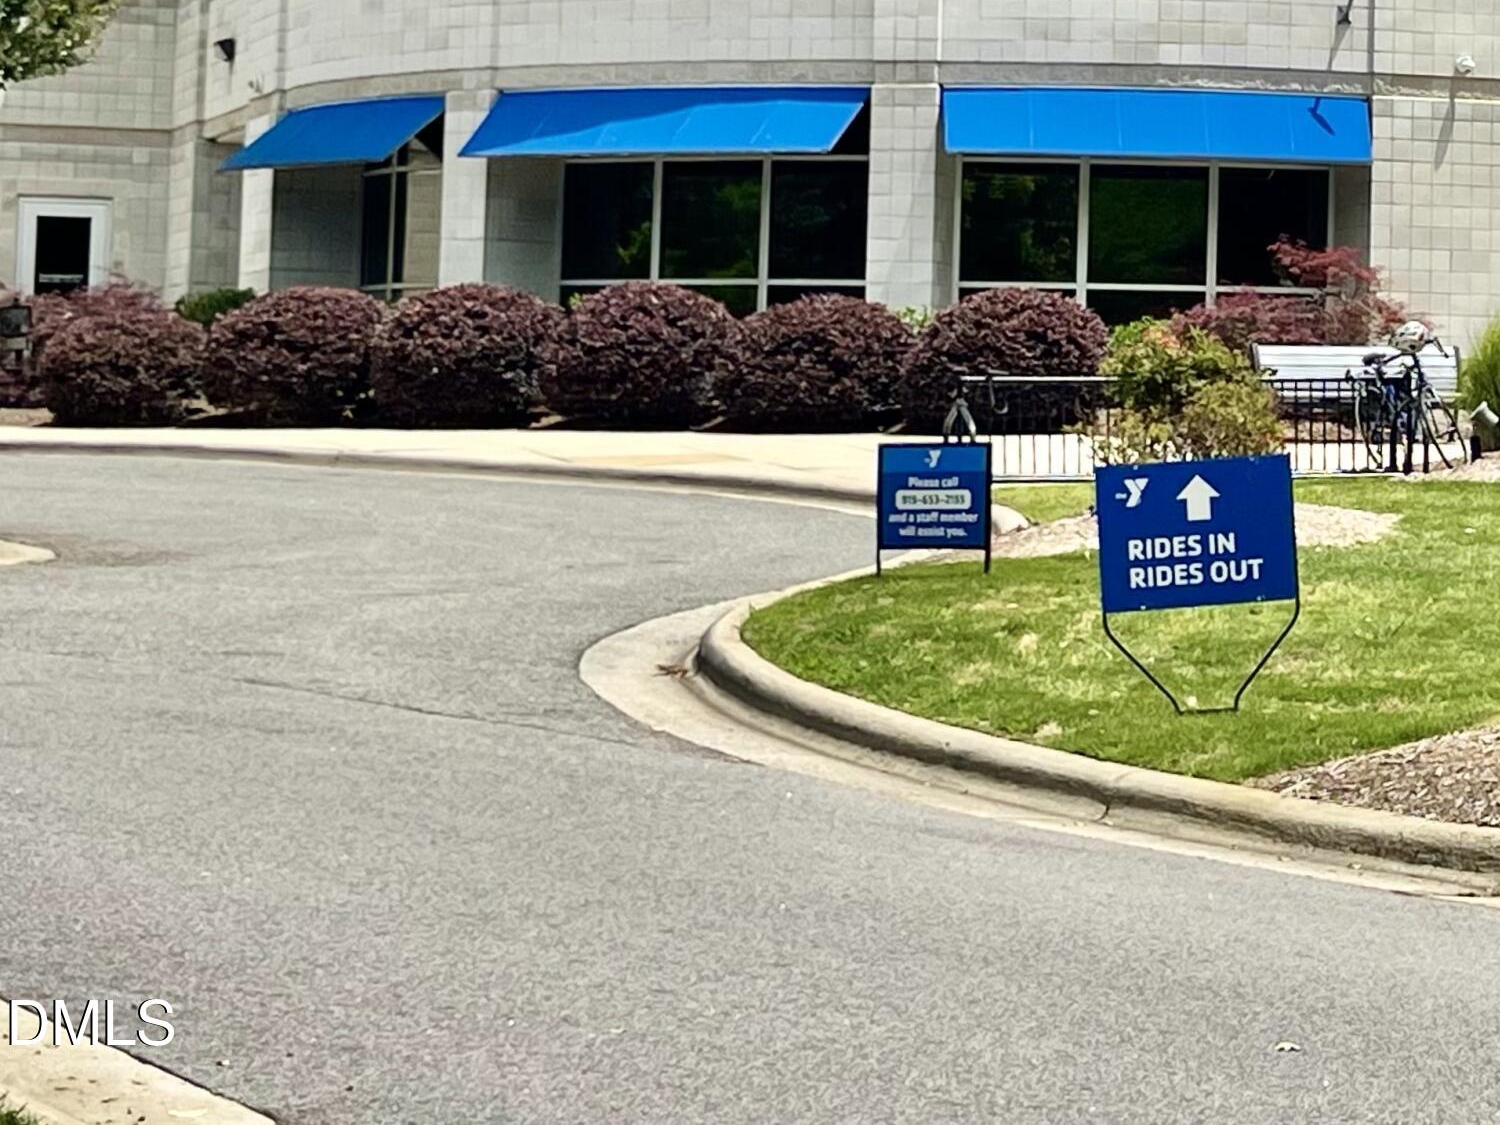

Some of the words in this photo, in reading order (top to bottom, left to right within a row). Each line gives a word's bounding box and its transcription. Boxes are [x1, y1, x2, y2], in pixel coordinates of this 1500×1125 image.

[908, 476, 940, 488] Please
[941, 476, 959, 488] call
[888, 513, 908, 523] and
[916, 511, 939, 523] staff
[940, 511, 979, 523] member
[899, 525, 916, 536] will
[917, 526, 945, 536] assist
[1128, 535, 1202, 561] RIDES
[1208, 532, 1236, 555] IN
[1129, 563, 1204, 589] RIDES
[1210, 558, 1264, 583] OUT
